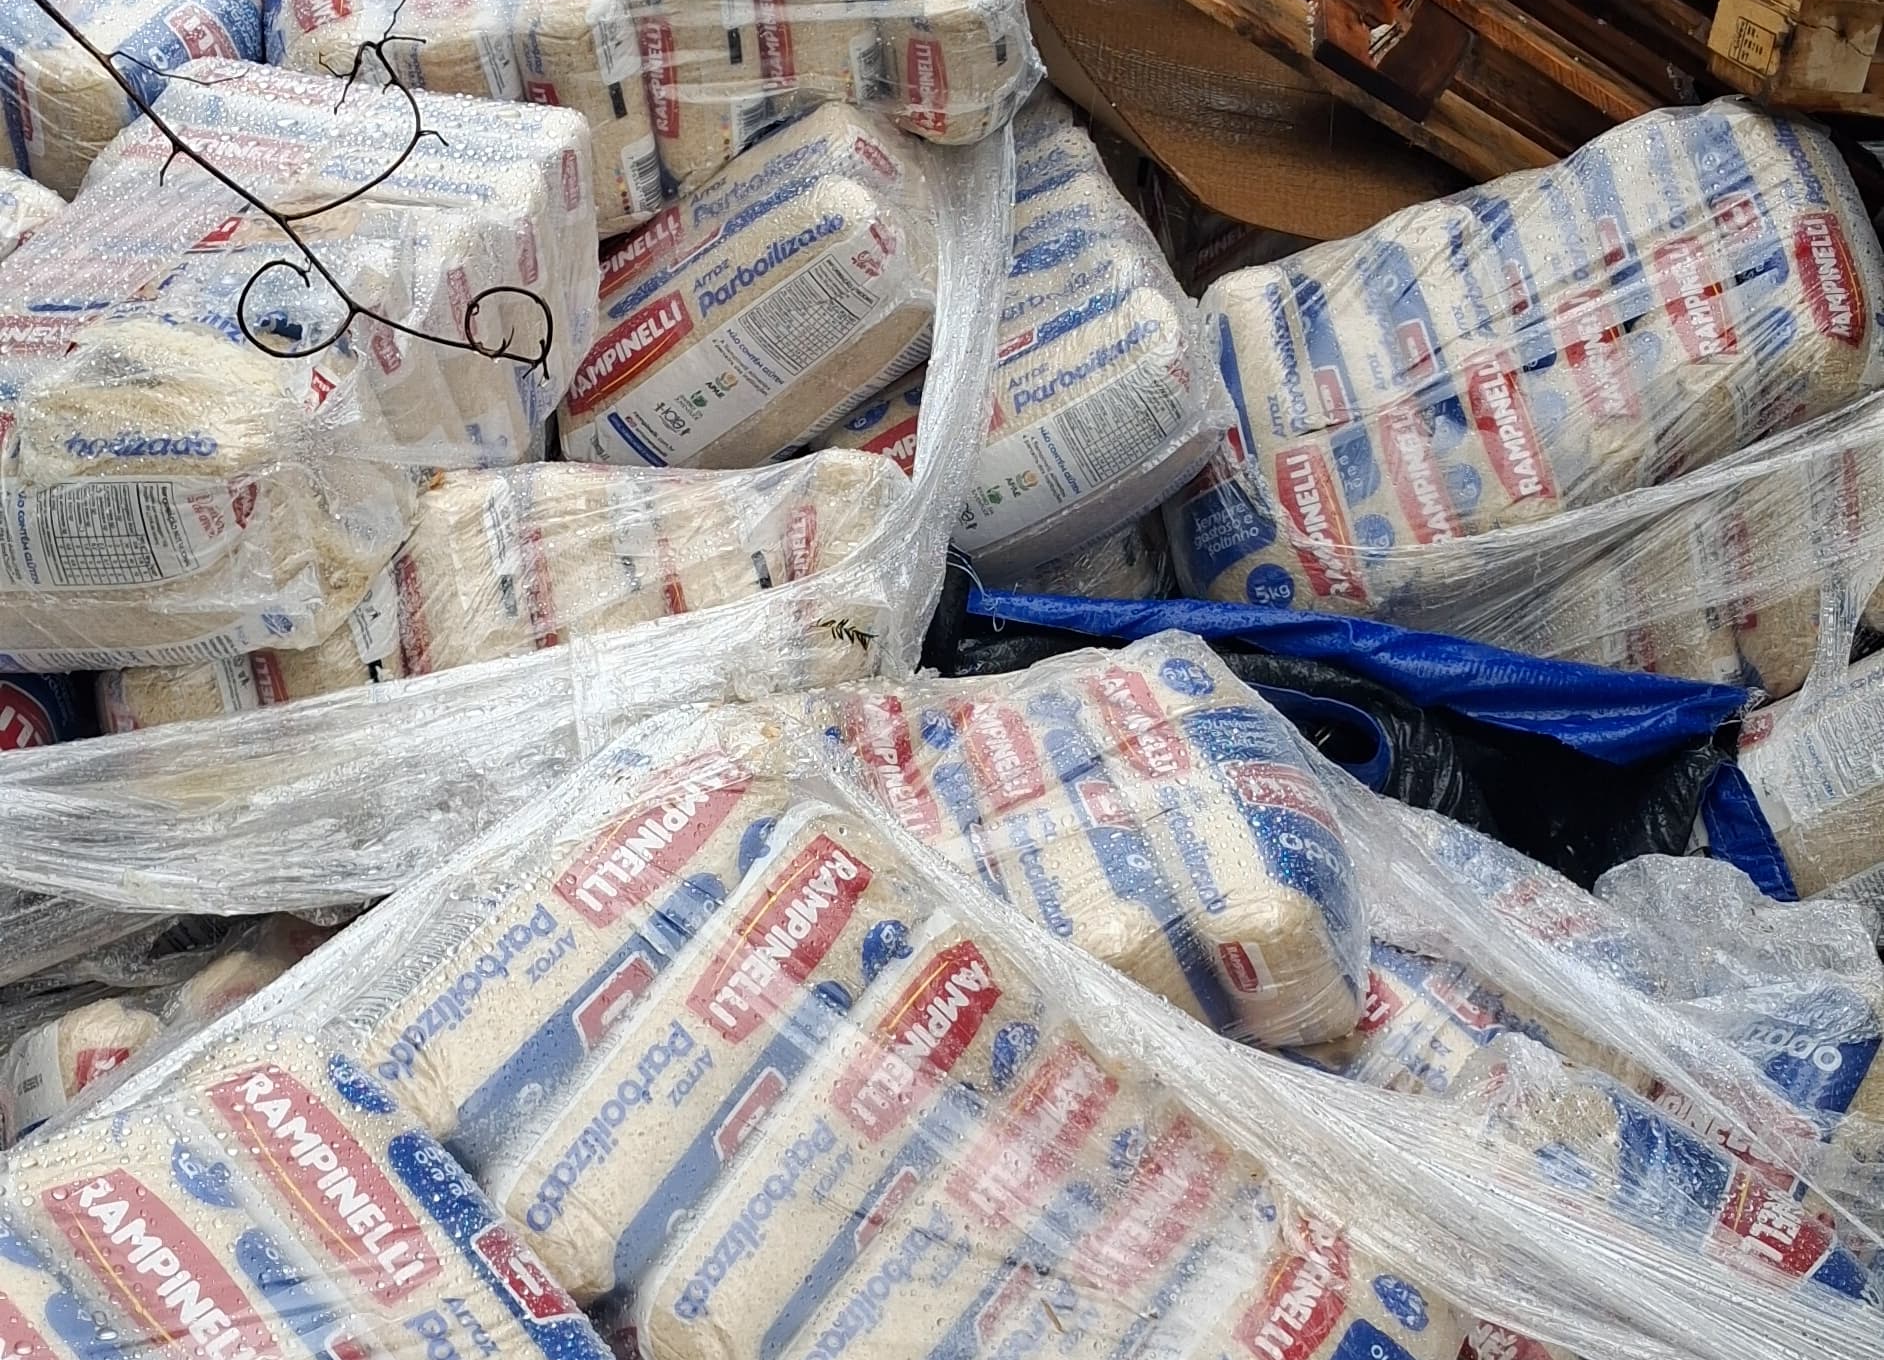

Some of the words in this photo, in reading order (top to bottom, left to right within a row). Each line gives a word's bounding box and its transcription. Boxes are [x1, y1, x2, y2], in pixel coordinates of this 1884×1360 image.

[599, 213, 682, 286] PINELLI
[693, 259, 730, 292] Arroz
[698, 213, 845, 318] Parboilizado
[1479, 356, 1543, 497] RAMPINELLI
[1254, 582, 1291, 601] 5kg
[525, 927, 577, 986] Arroz
[708, 846, 863, 1030] RAMPINELLI
[668, 1047, 714, 1110] Arroz
[526, 1017, 698, 1233] Parboilizado
[238, 1070, 426, 1285] RAMPINELLI
[442, 1295, 499, 1359] Arroz
